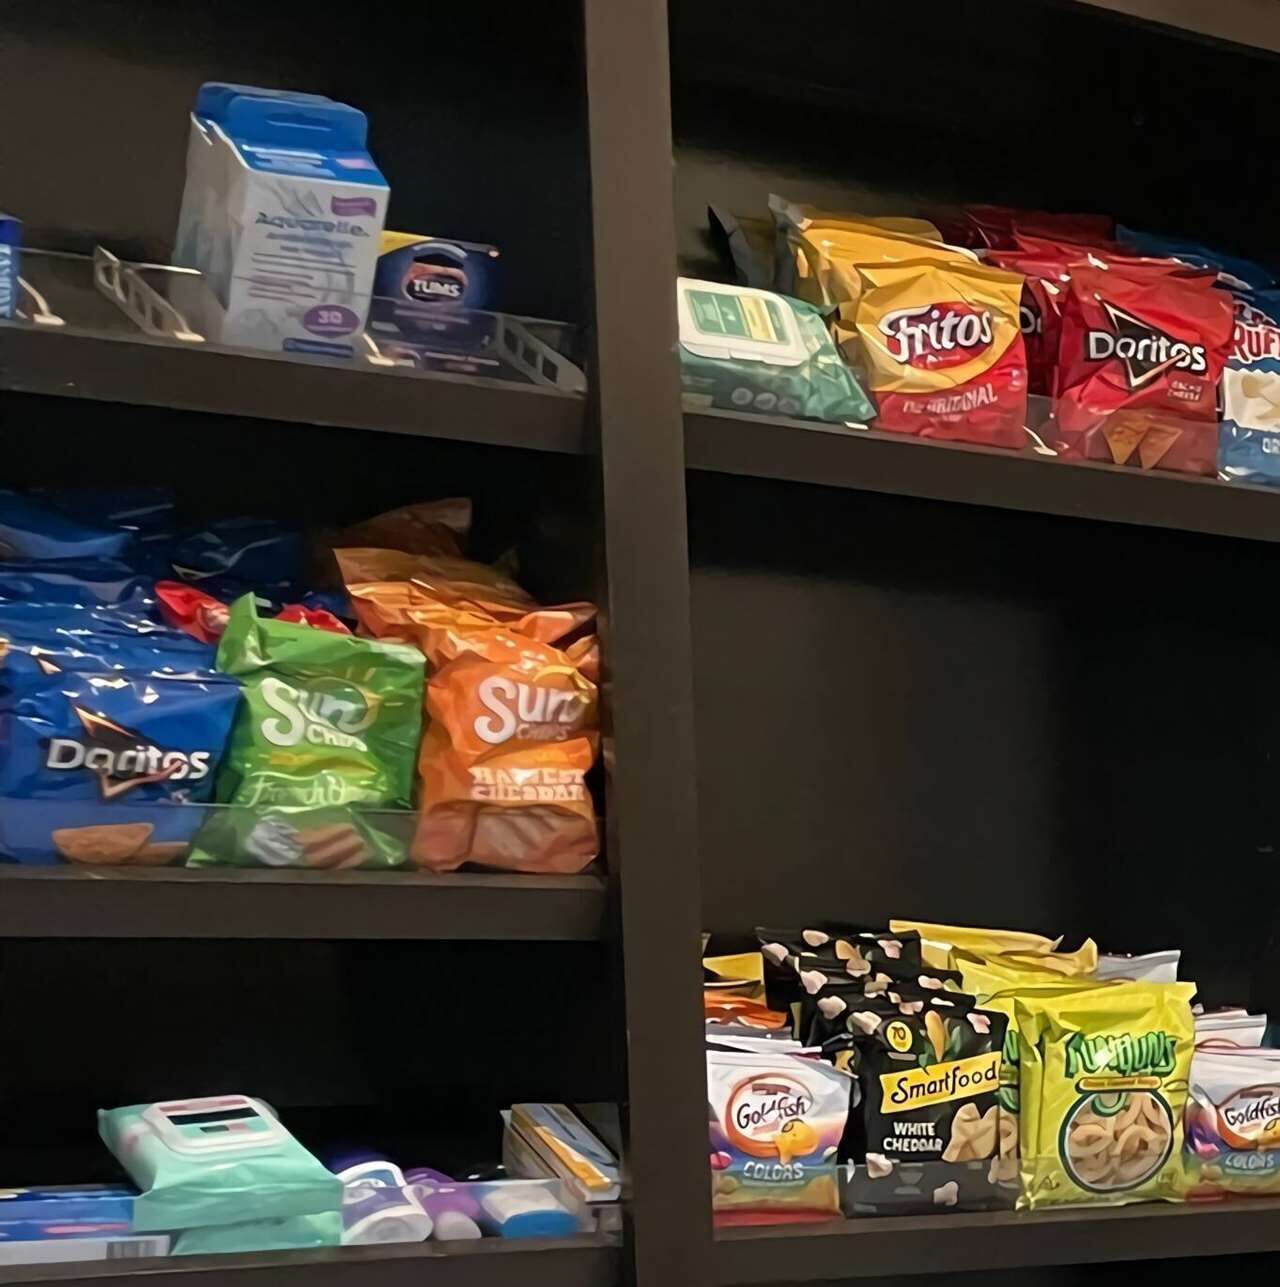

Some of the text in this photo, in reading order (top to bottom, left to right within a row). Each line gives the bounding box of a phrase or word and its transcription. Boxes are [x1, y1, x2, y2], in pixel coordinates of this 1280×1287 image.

[413, 278, 462, 298] TUMS
[878, 303, 993, 364] Fritos
[1089, 331, 1207, 371] Doritos
[46, 738, 210, 781] Doritos
[891, 1060, 998, 1106] Smartfood
[883, 1136, 943, 1153] CHEDDAR
[893, 1122, 936, 1137] WHITE
